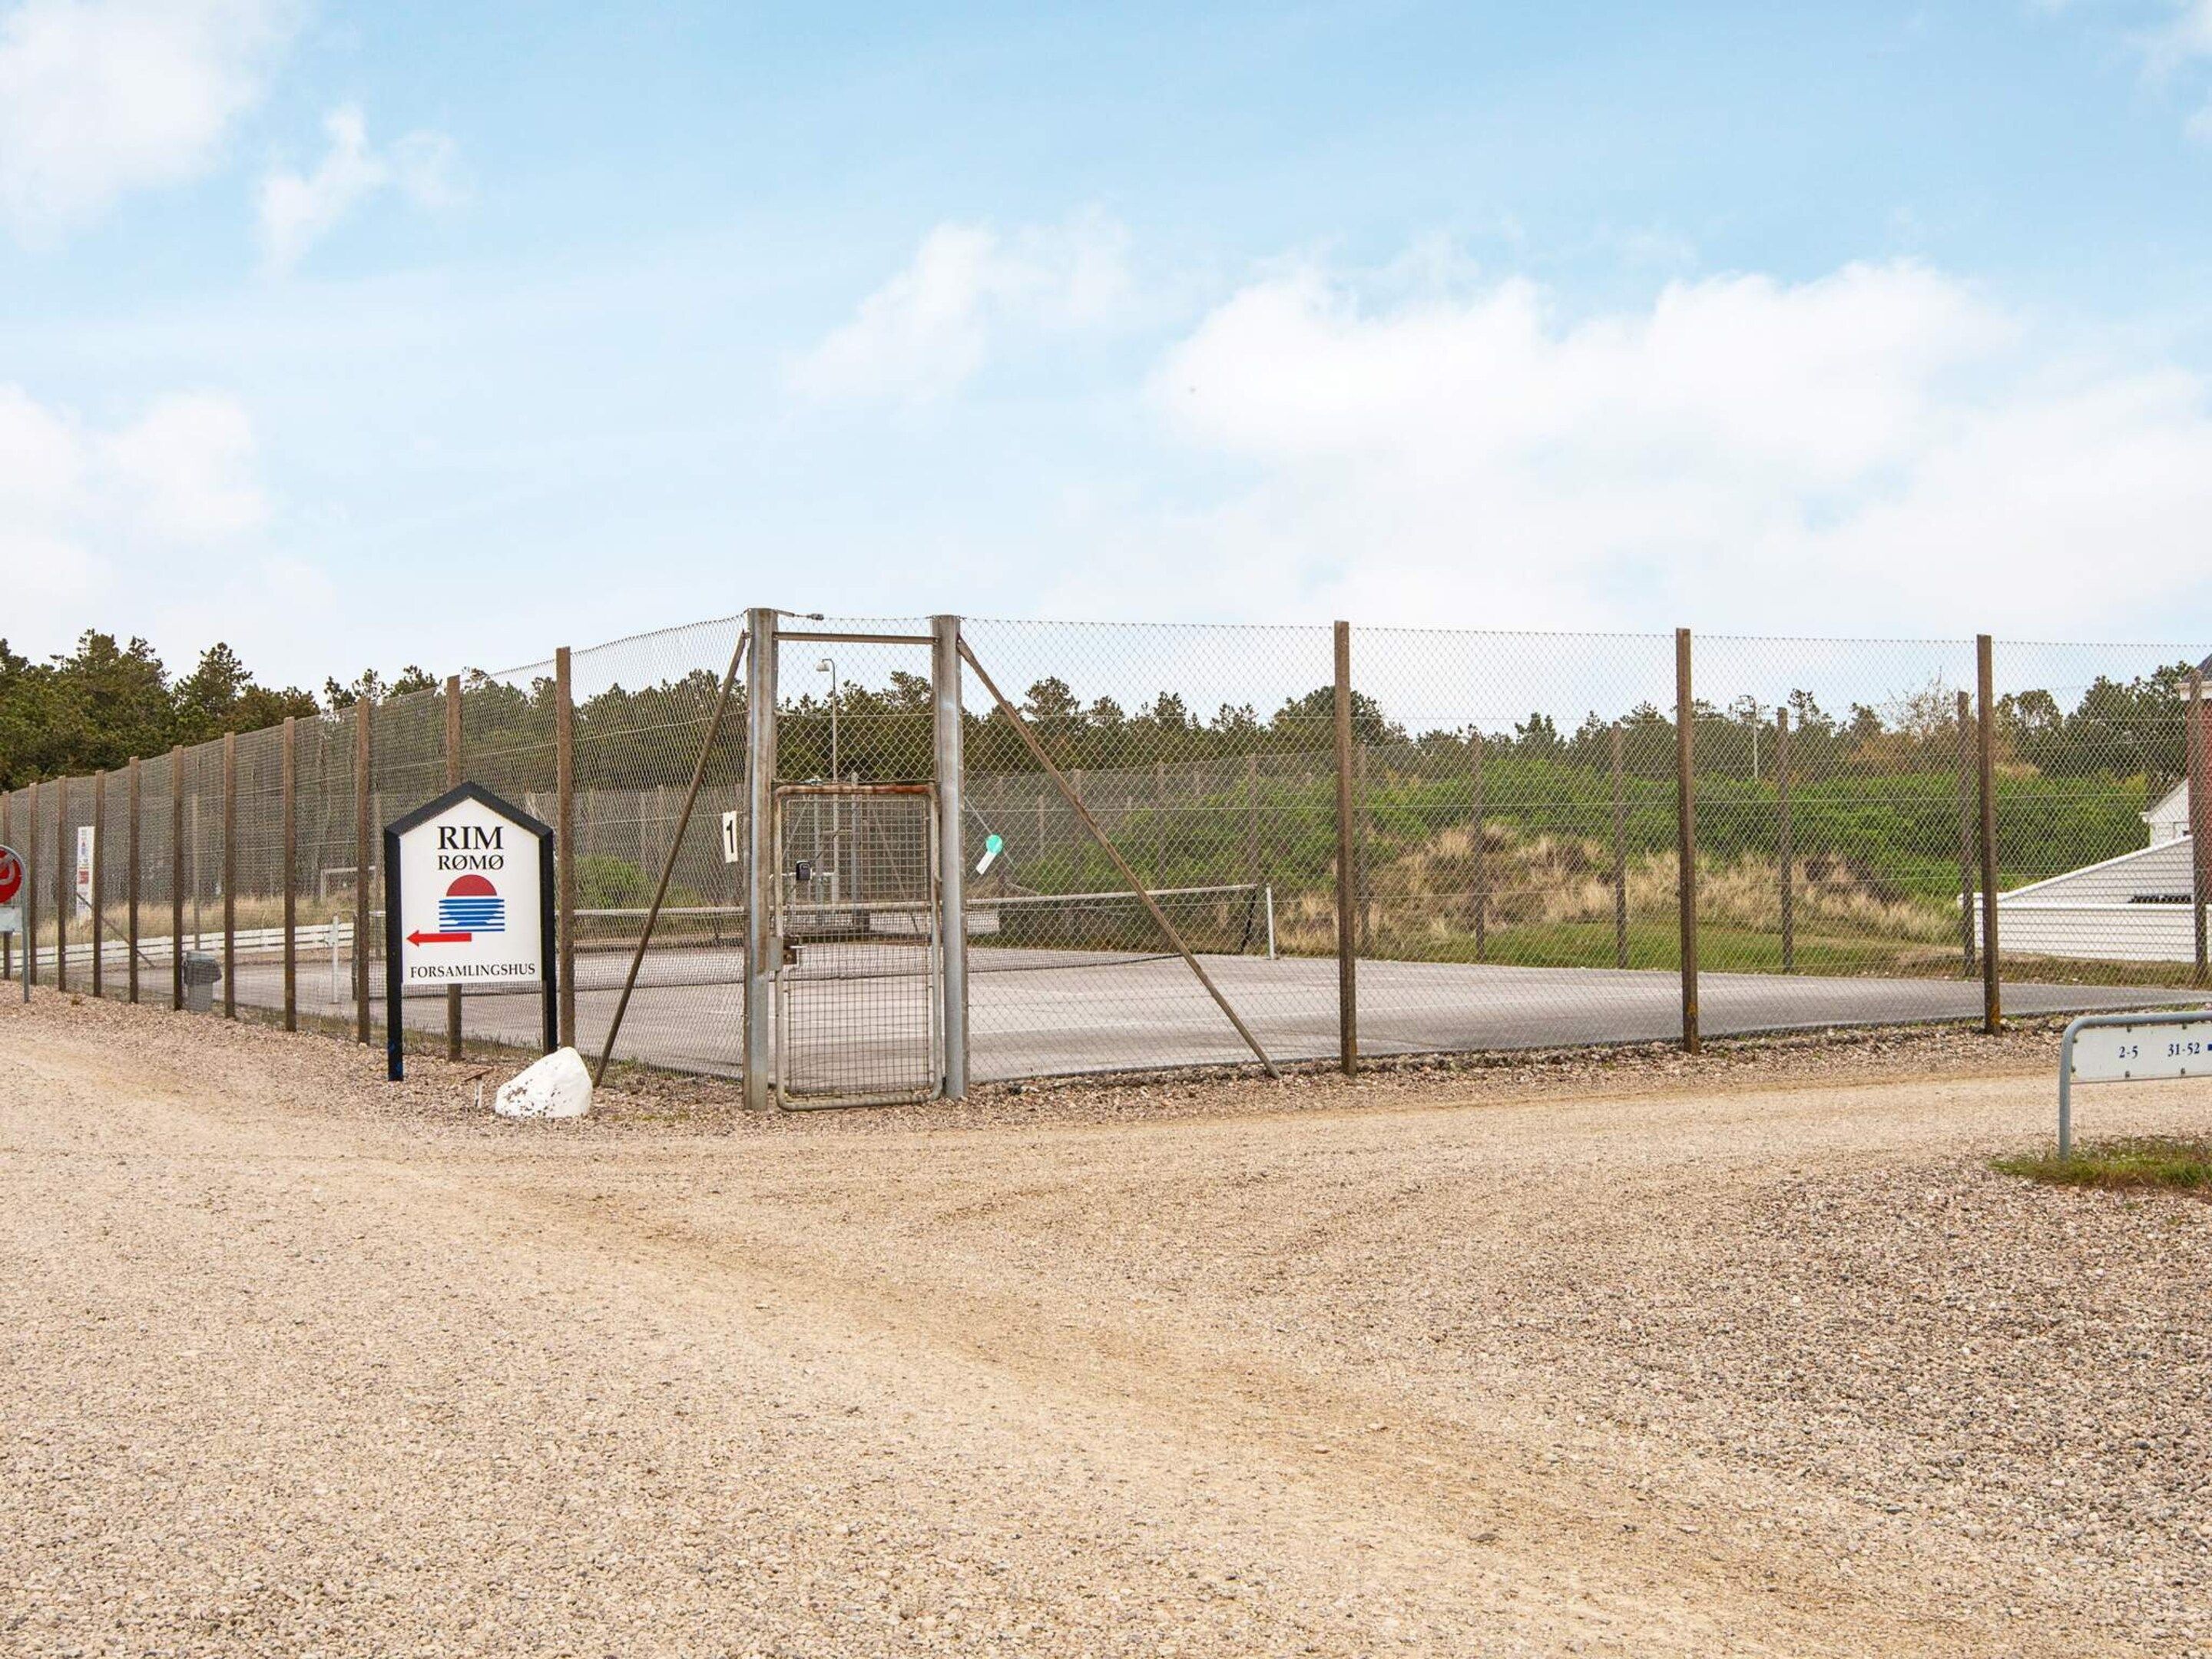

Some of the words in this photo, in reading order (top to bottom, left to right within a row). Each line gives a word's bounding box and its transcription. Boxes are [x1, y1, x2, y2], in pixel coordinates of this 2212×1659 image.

[438, 826, 504, 849] RIM
[726, 820, 734, 854] 1
[438, 855, 504, 870] RØMØ
[410, 963, 536, 978] FORSAMLINGSHUS
[2119, 1045, 2138, 1059] 2-5
[2167, 1042, 2200, 1058] 31-52
